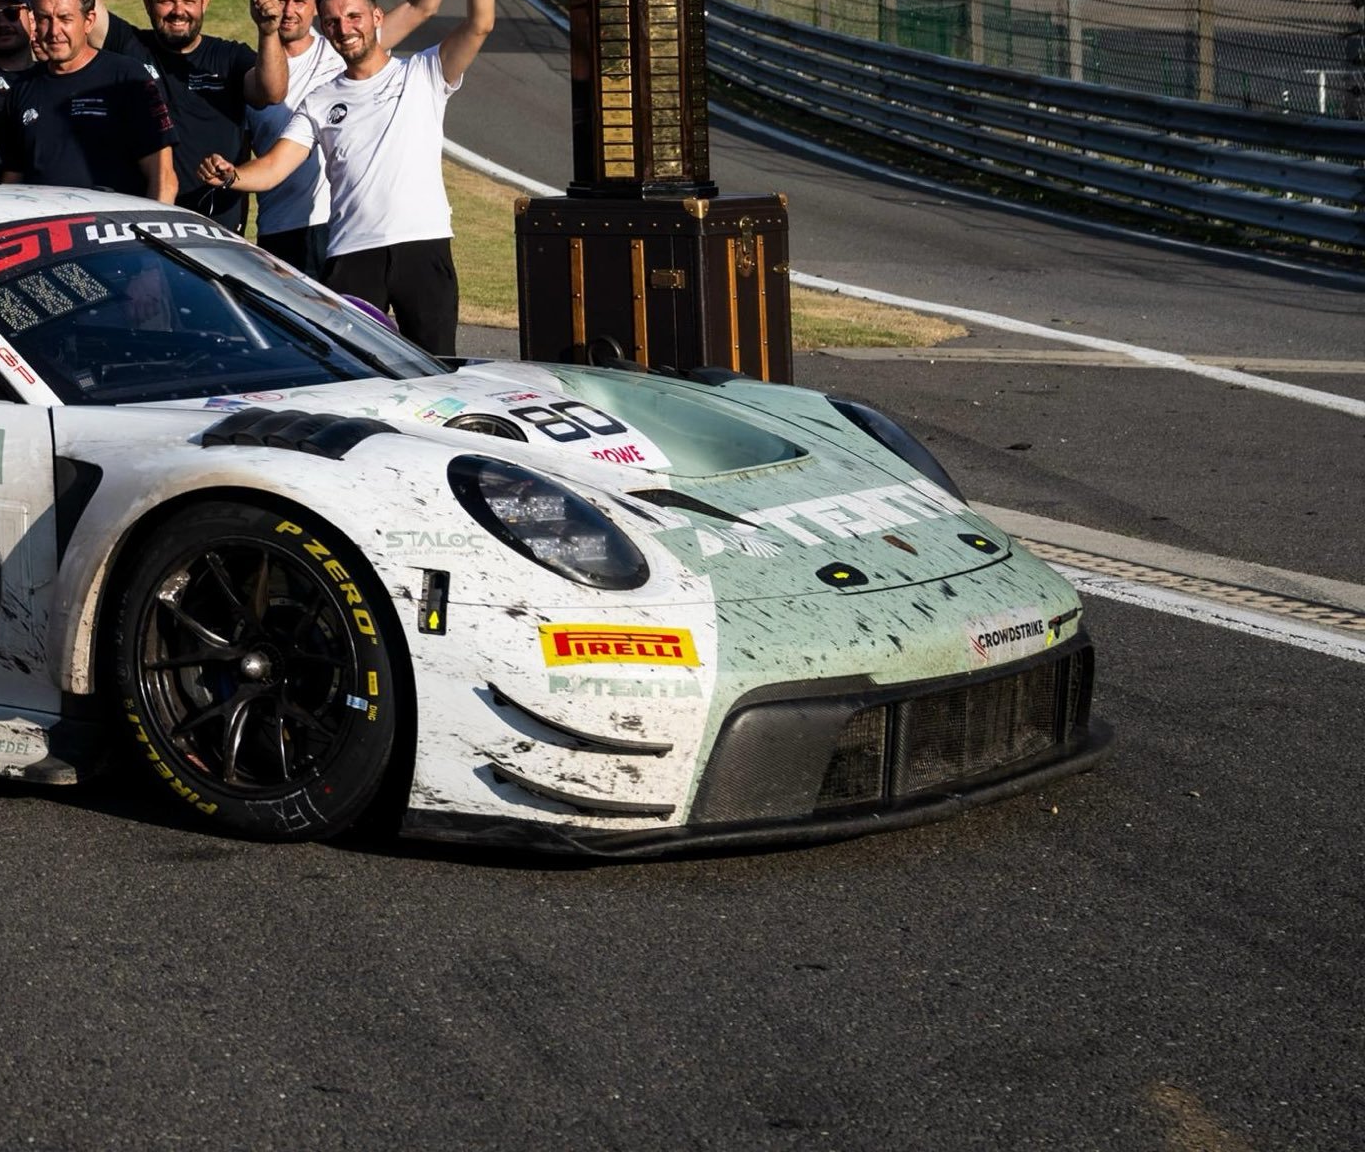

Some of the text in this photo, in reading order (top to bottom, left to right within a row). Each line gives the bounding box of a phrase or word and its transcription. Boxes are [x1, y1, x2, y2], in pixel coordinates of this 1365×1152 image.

[508, 401, 628, 443] 80
[275, 521, 304, 537] P
[386, 531, 487, 550] STALOC
[553, 632, 683, 659] PIRELLI
[978, 619, 1045, 649] CROWDSTRIKE
